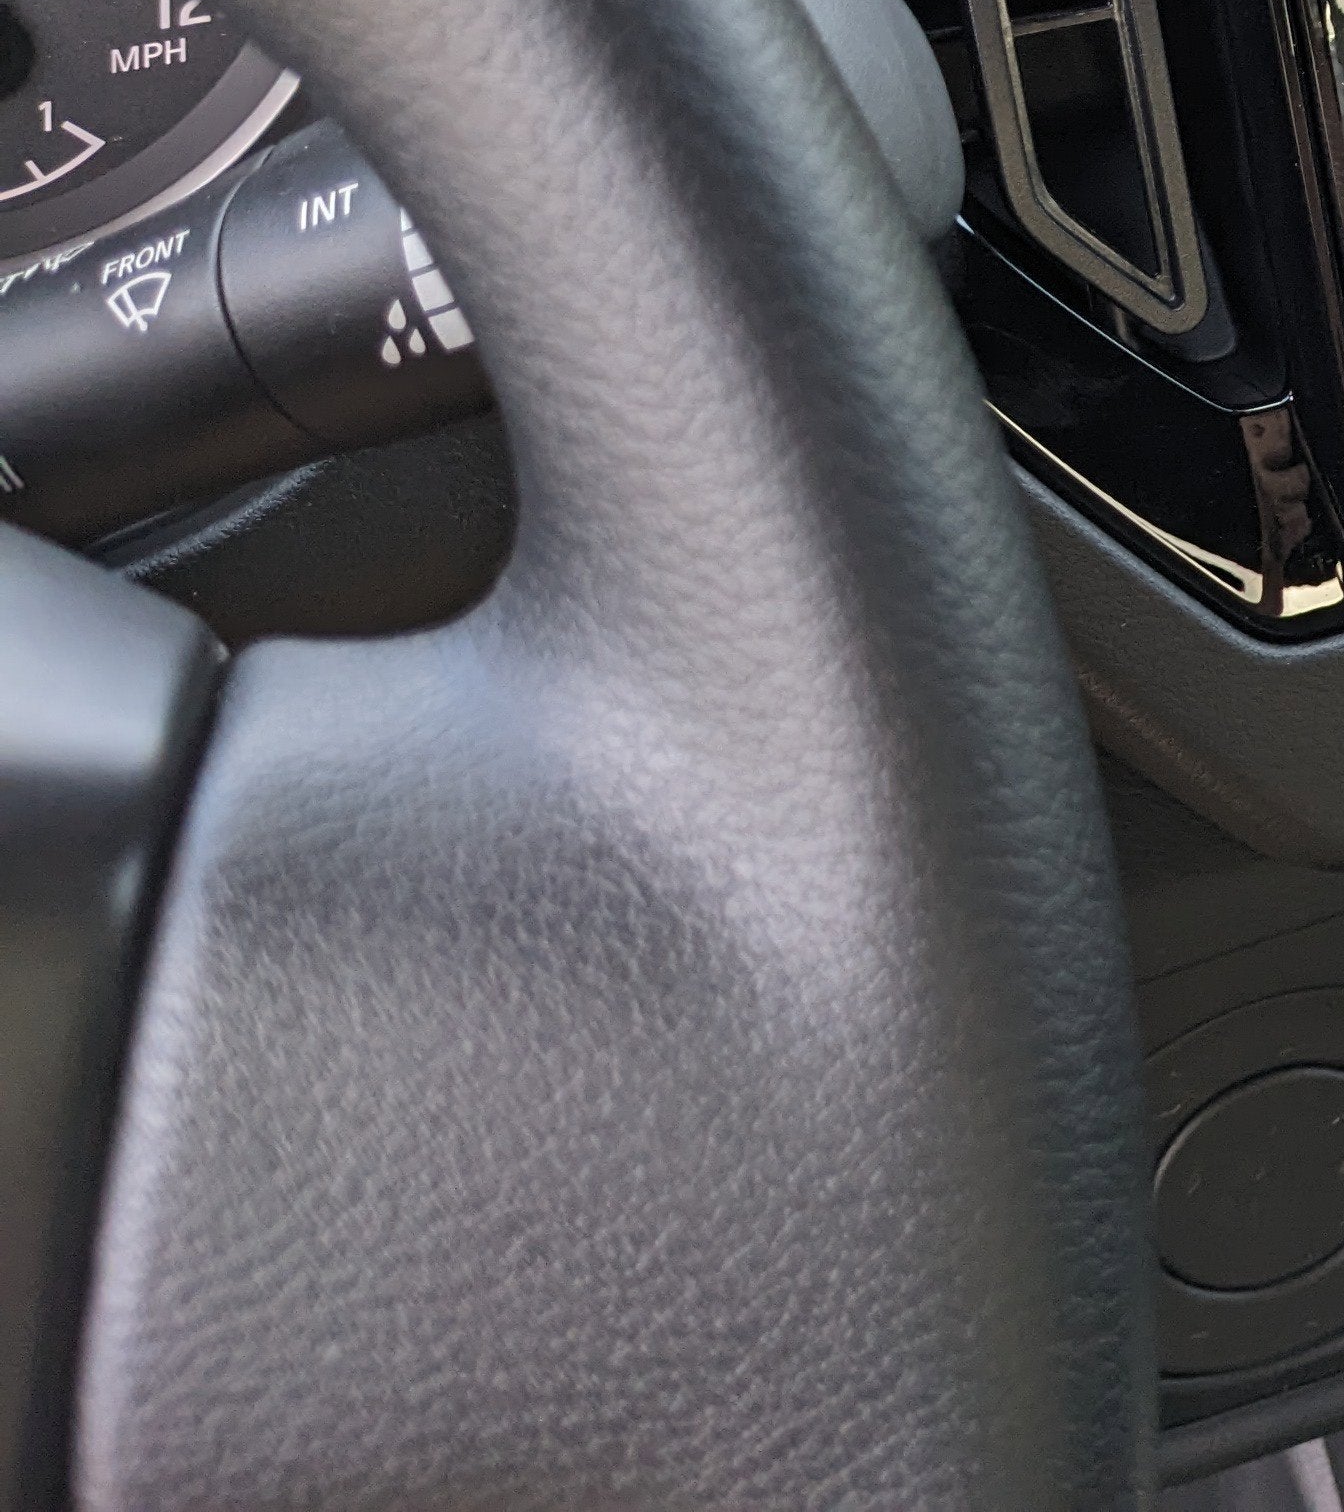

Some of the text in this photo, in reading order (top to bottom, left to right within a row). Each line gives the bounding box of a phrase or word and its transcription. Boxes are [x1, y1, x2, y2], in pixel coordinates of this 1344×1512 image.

[109, 38, 187, 74] MPH
[38, 100, 52, 132] 1
[299, 183, 358, 230] INT
[102, 229, 190, 284] FRONT
